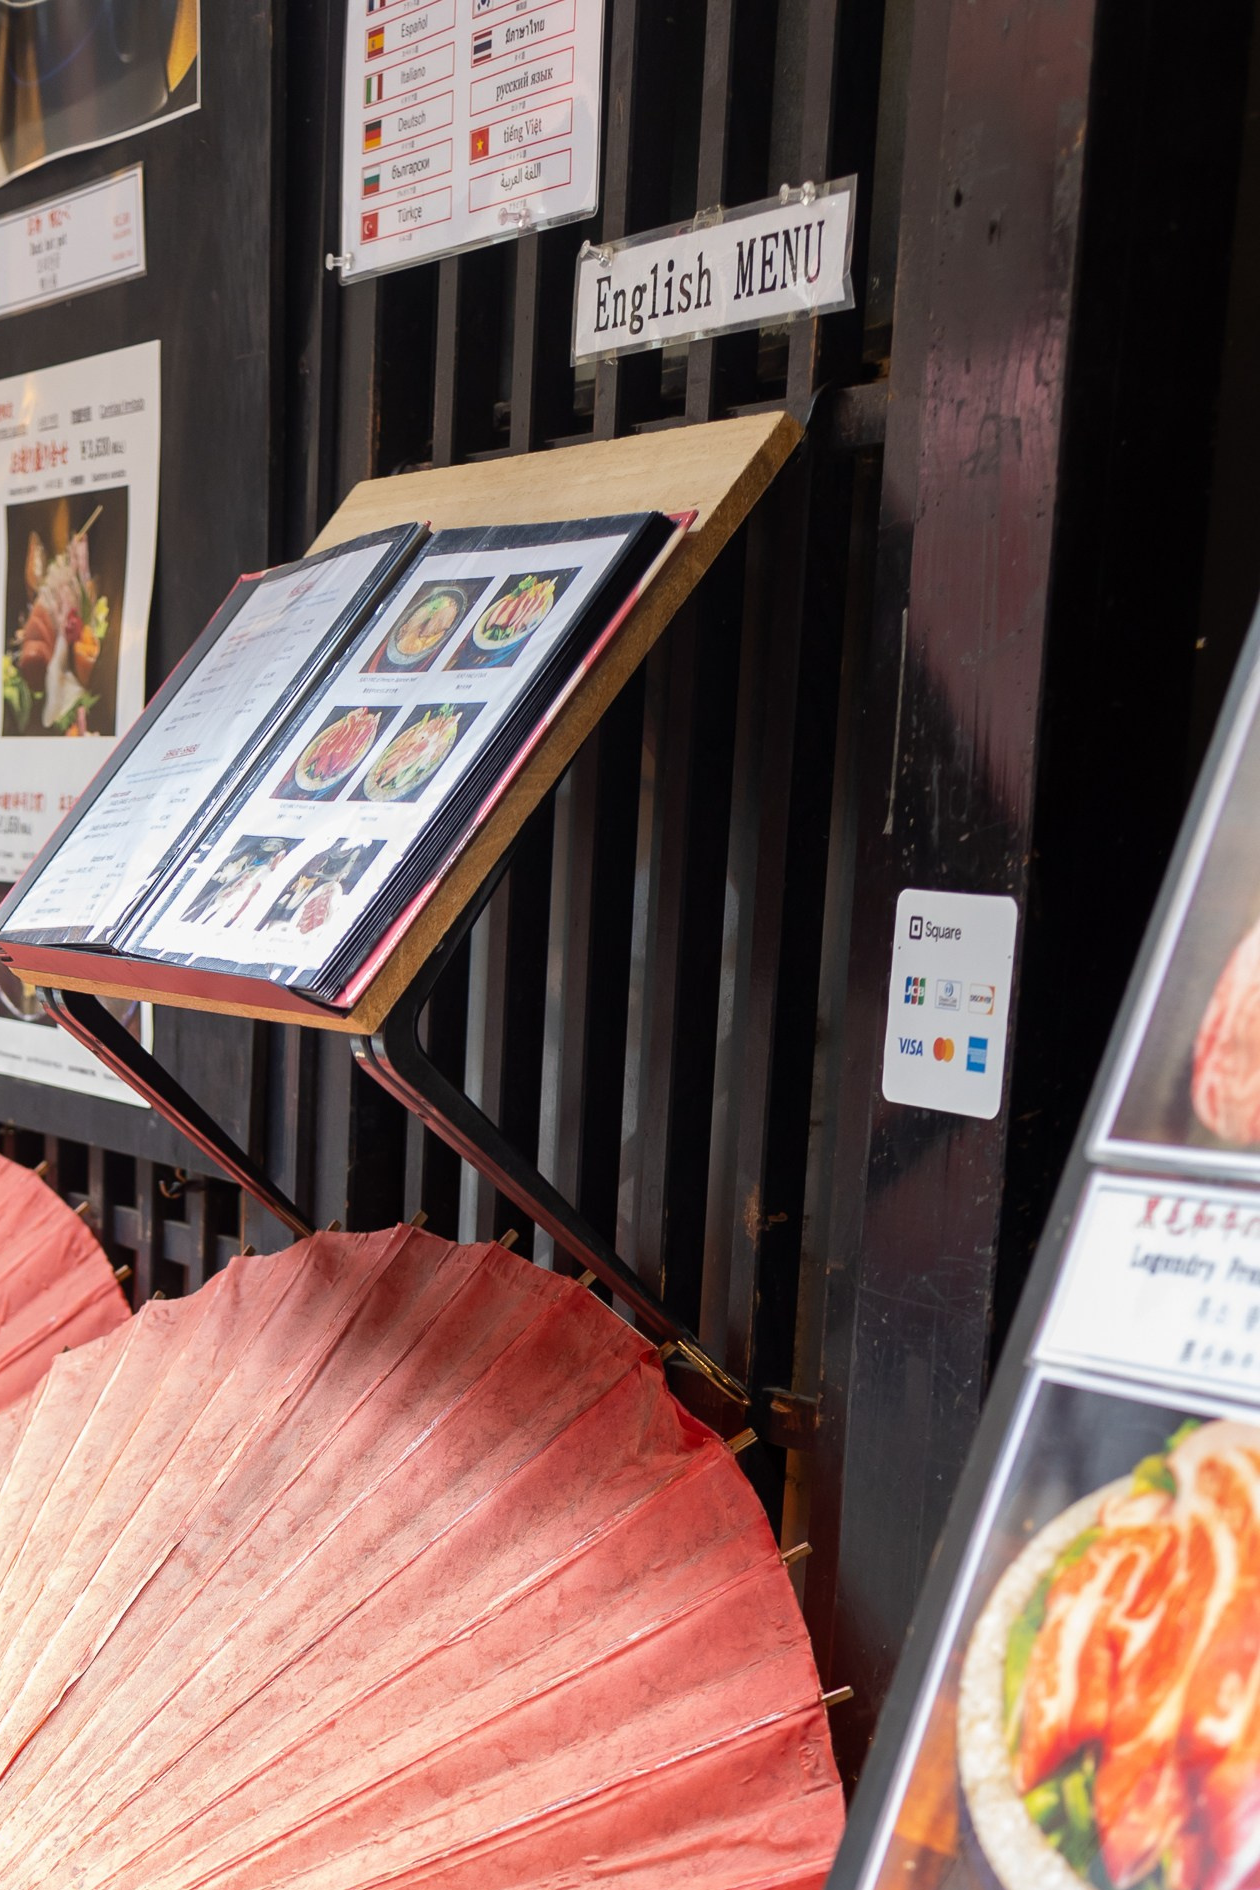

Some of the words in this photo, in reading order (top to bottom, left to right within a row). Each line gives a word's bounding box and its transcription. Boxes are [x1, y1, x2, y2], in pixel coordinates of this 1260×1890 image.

[401, 14, 428, 38] Español
[400, 66, 426, 84] Italiano
[496, 71, 529, 101] русский
[530, 67, 553, 86] язык
[398, 110, 426, 132] Deutsch
[525, 118, 542, 136] Việt
[391, 157, 430, 180] български
[397, 206, 422, 222] Türkçe
[594, 251, 712, 335] English
[733, 220, 825, 300] MENU
[925, 921, 962, 942] Square
[898, 1037, 923, 1057] VISA
